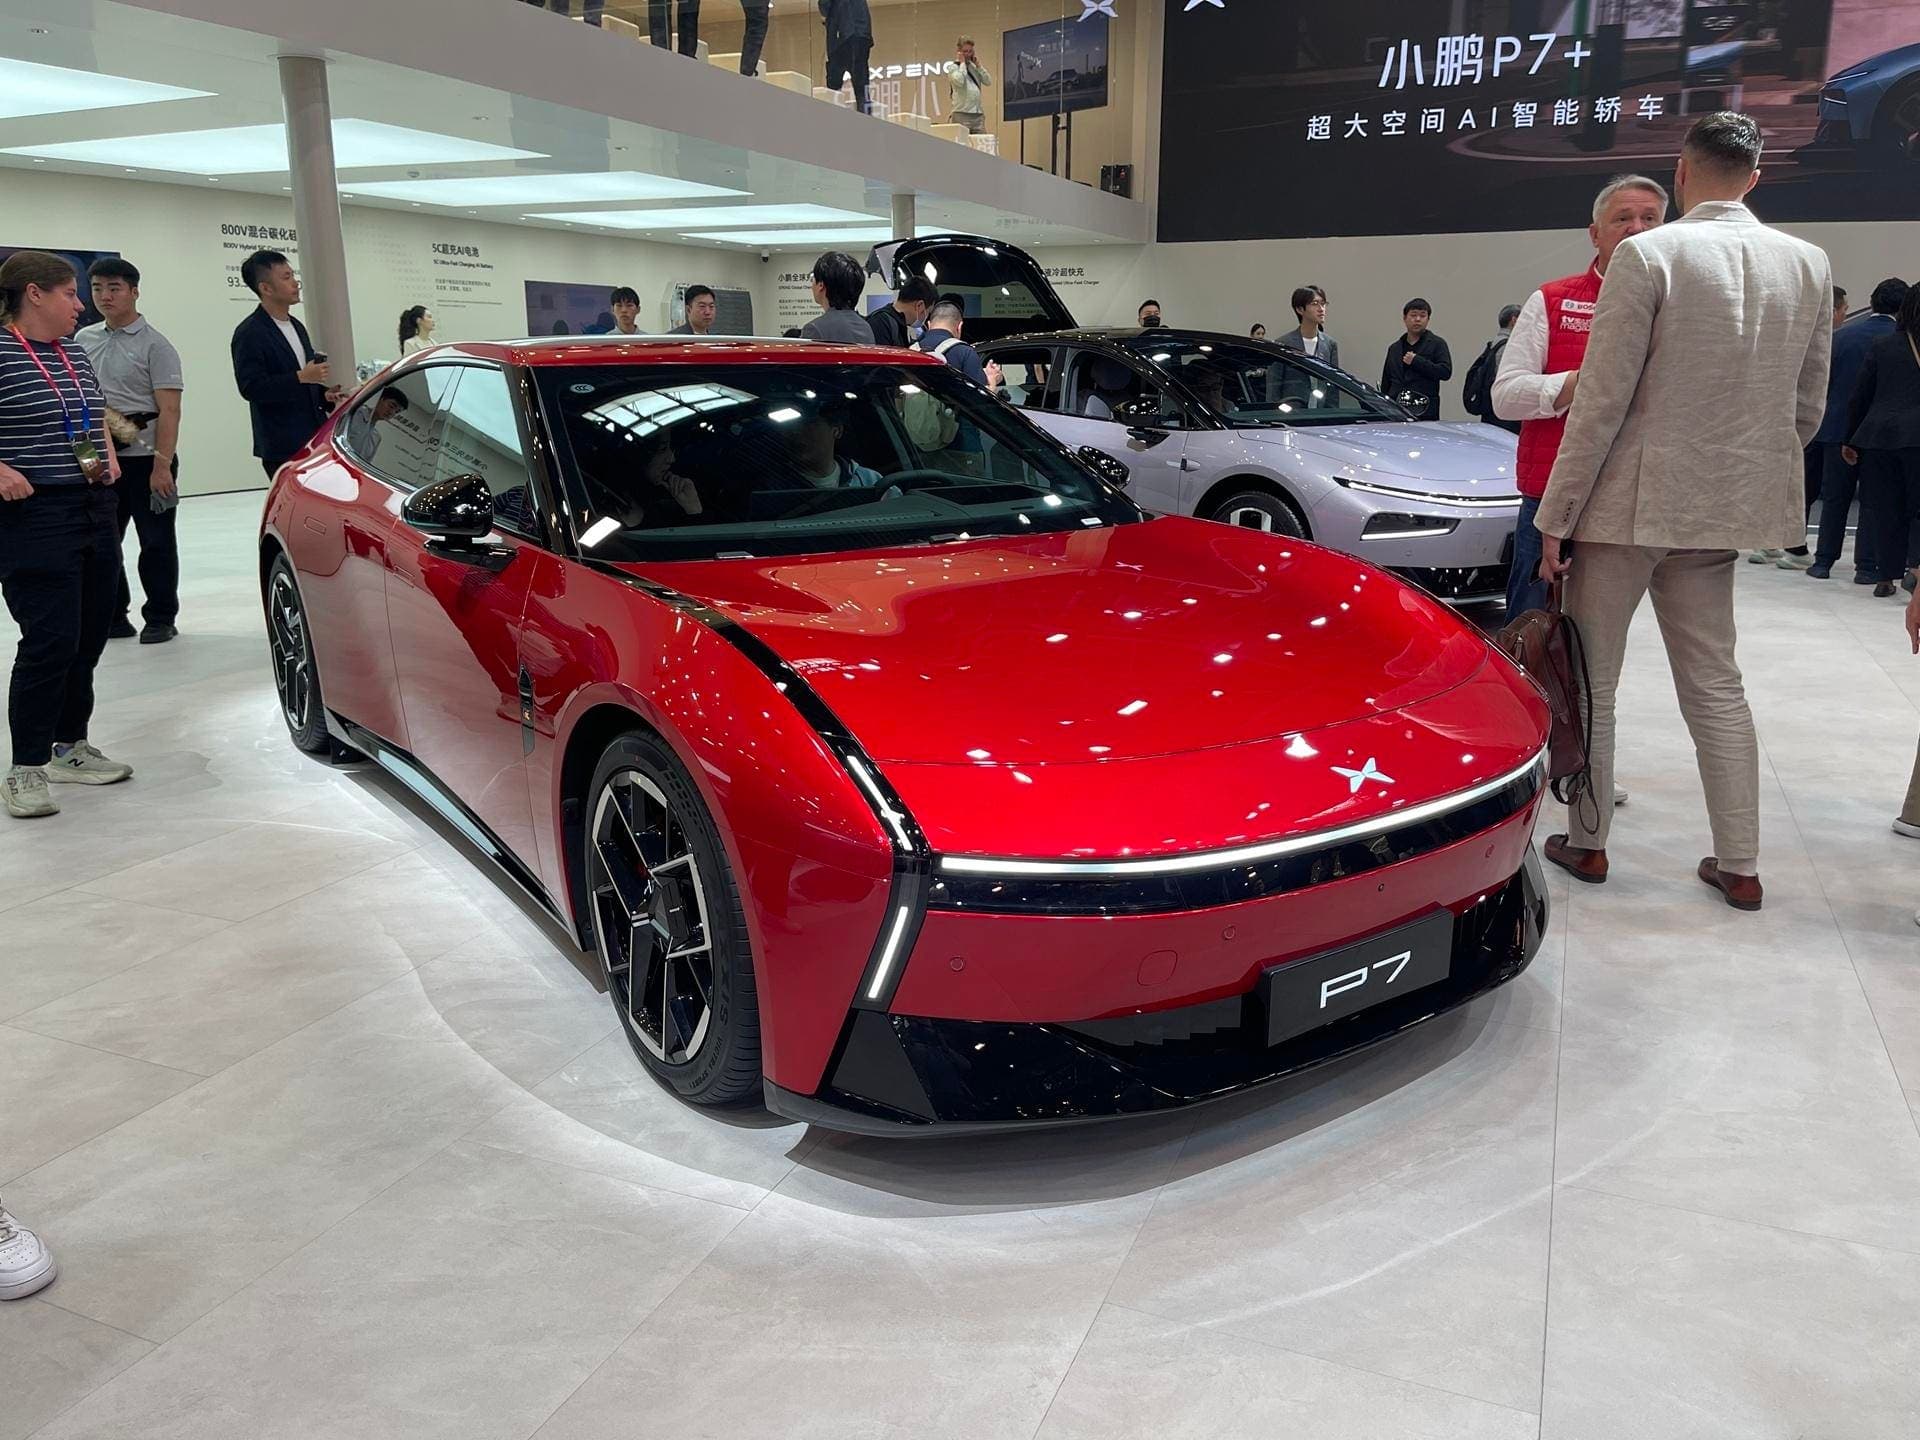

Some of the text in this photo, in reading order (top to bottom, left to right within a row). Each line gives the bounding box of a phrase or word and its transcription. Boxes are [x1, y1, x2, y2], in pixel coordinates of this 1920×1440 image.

[1378, 33, 1591, 90] 小鹏P7+
[1306, 94, 1664, 141] 超大空间AI智能轿车
[221, 224, 297, 241] 800V混合碳化硅
[432, 243, 479, 257] 5C超充AI电池
[1320, 950, 1412, 1010] P7
